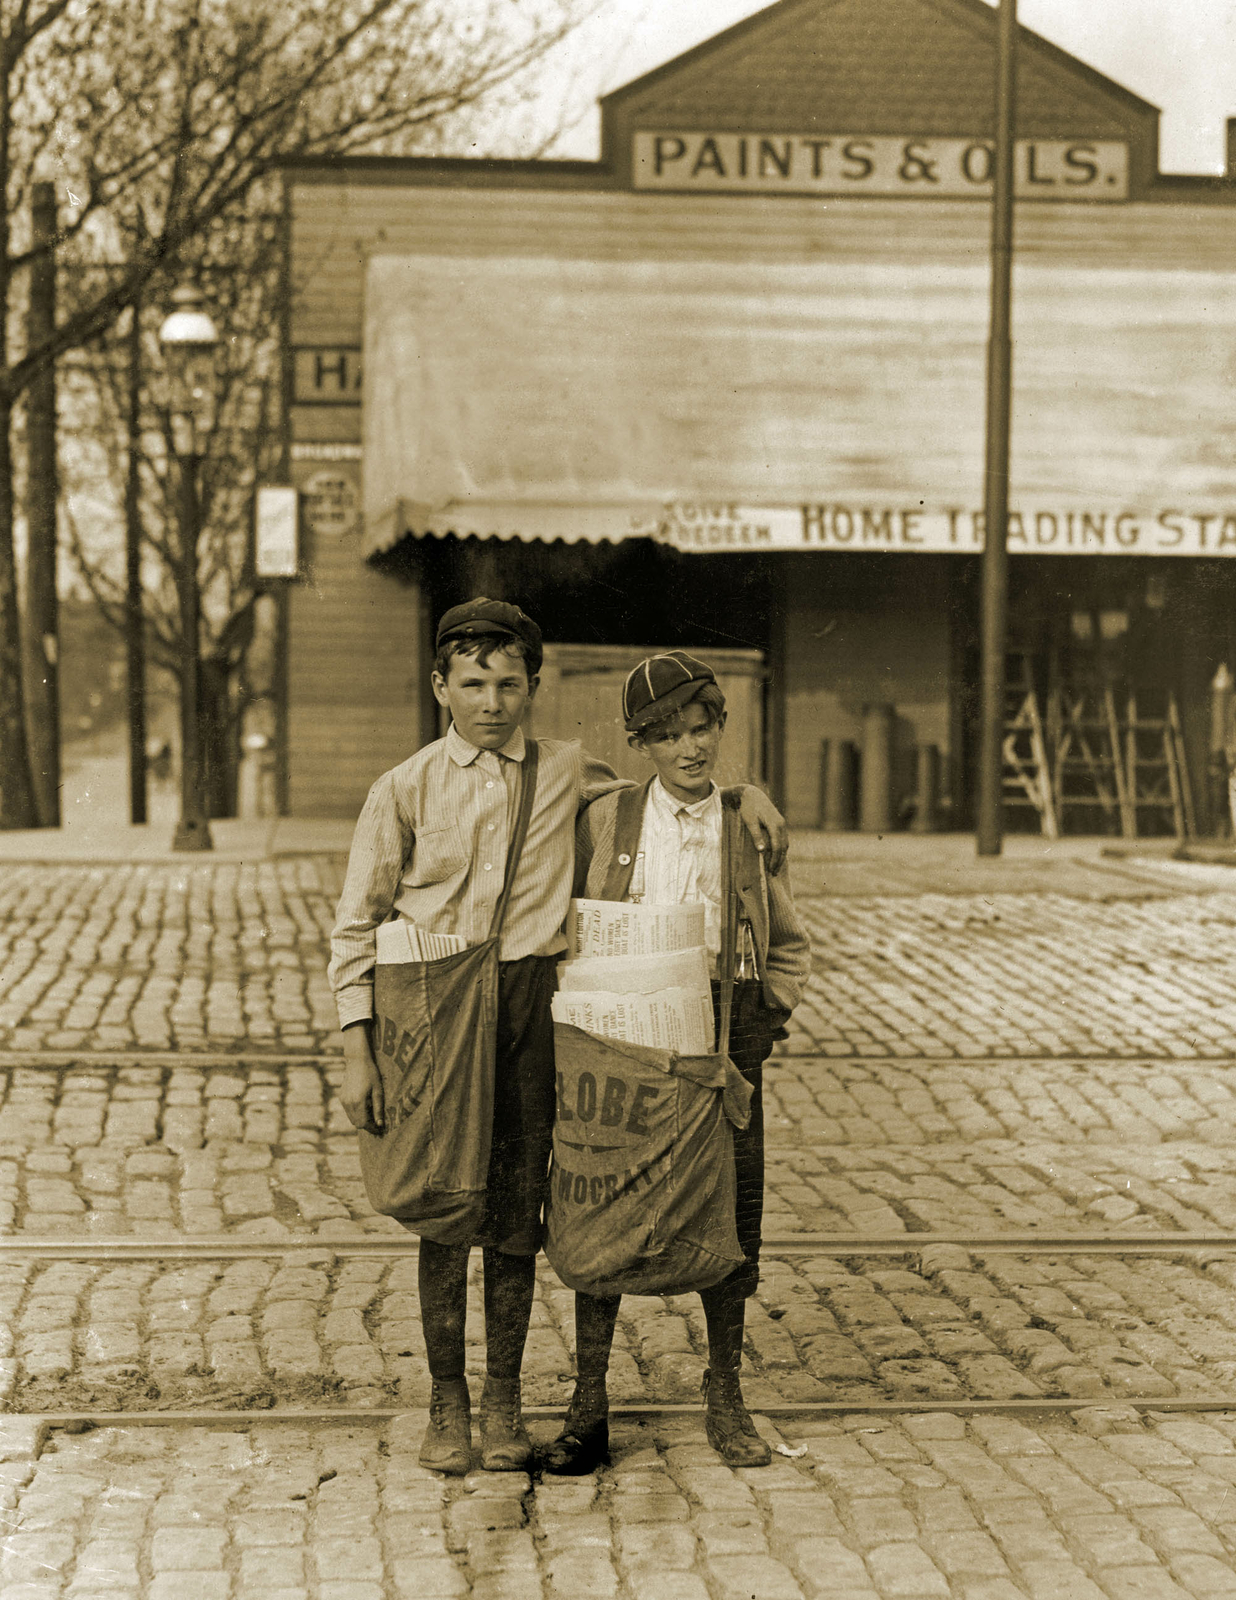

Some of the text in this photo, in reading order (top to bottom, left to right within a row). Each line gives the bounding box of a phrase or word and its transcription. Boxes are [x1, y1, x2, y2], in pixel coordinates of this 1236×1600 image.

[653, 136, 1119, 187] PAINTS & OLS.
[315, 355, 361, 389] H
[801, 504, 925, 544] HOME
[592, 910, 601, 942] DEAD
[617, 1003, 625, 1018] LOST
[554, 1159, 654, 1206] MOCRAT
